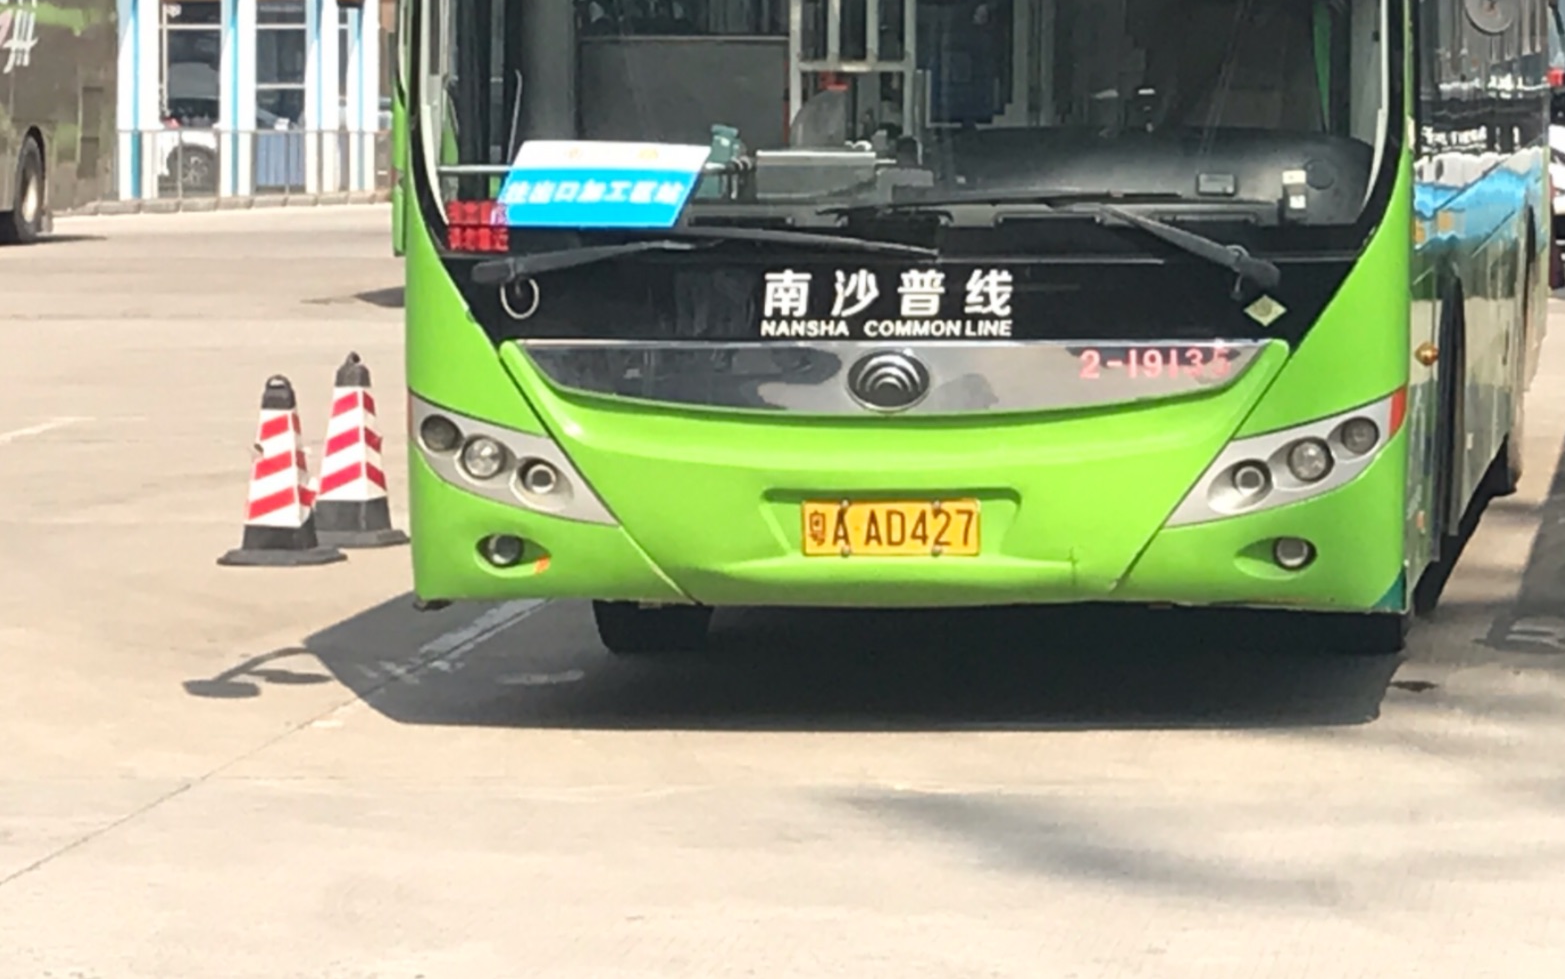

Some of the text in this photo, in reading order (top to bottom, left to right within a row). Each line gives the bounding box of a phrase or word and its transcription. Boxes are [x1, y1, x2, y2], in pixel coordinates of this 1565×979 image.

[763, 268, 1014, 317] 南沙普线
[760, 319, 1013, 337] NANSHA COMMON LINE
[1078, 346, 1233, 380] 2-19135
